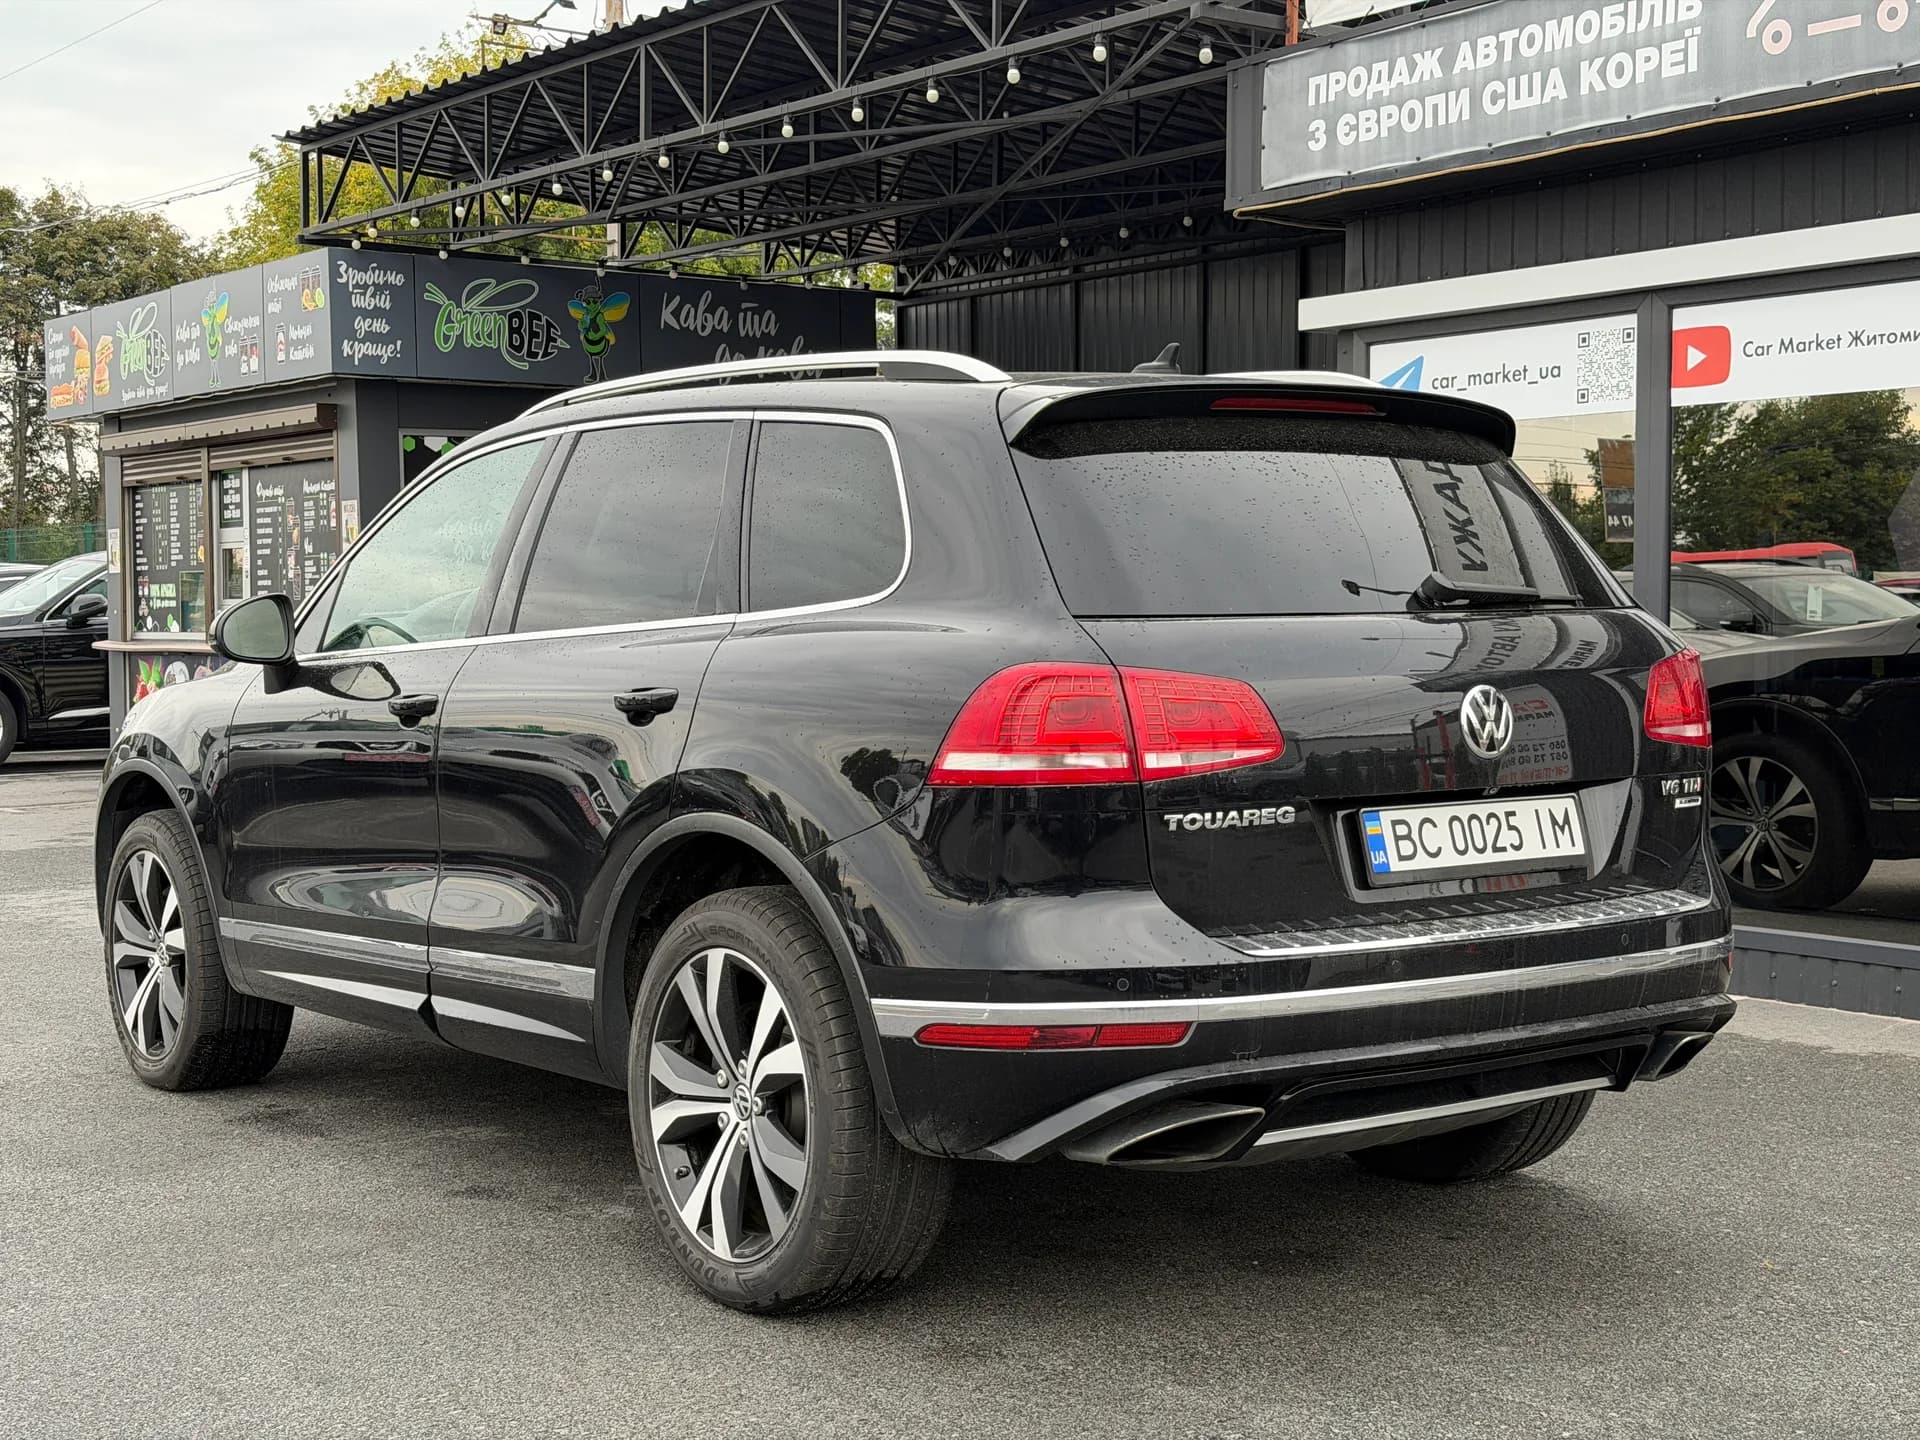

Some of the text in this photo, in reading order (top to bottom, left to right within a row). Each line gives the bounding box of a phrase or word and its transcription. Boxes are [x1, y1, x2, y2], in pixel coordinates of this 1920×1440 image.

[1307, 0, 1704, 107] ПРОДАЖ АВТОМОБІЛІВ
[1307, 26, 1703, 151] З ЄВРОПИ США КОРЕЇ
[337, 260, 406, 292] Зробимо
[351, 285, 392, 310] твій
[354, 315, 391, 339] день
[660, 290, 780, 338] Кава та
[341, 339, 402, 365] краще!
[1742, 340, 1773, 358] Car
[1778, 333, 1843, 355] Market
[1431, 362, 1562, 392] car_market_ua
[1661, 779, 1681, 796] V6
[1163, 805, 1296, 832] TOUAREG
[1447, 810, 1524, 857] 0025
[1370, 851, 1388, 865] UA
